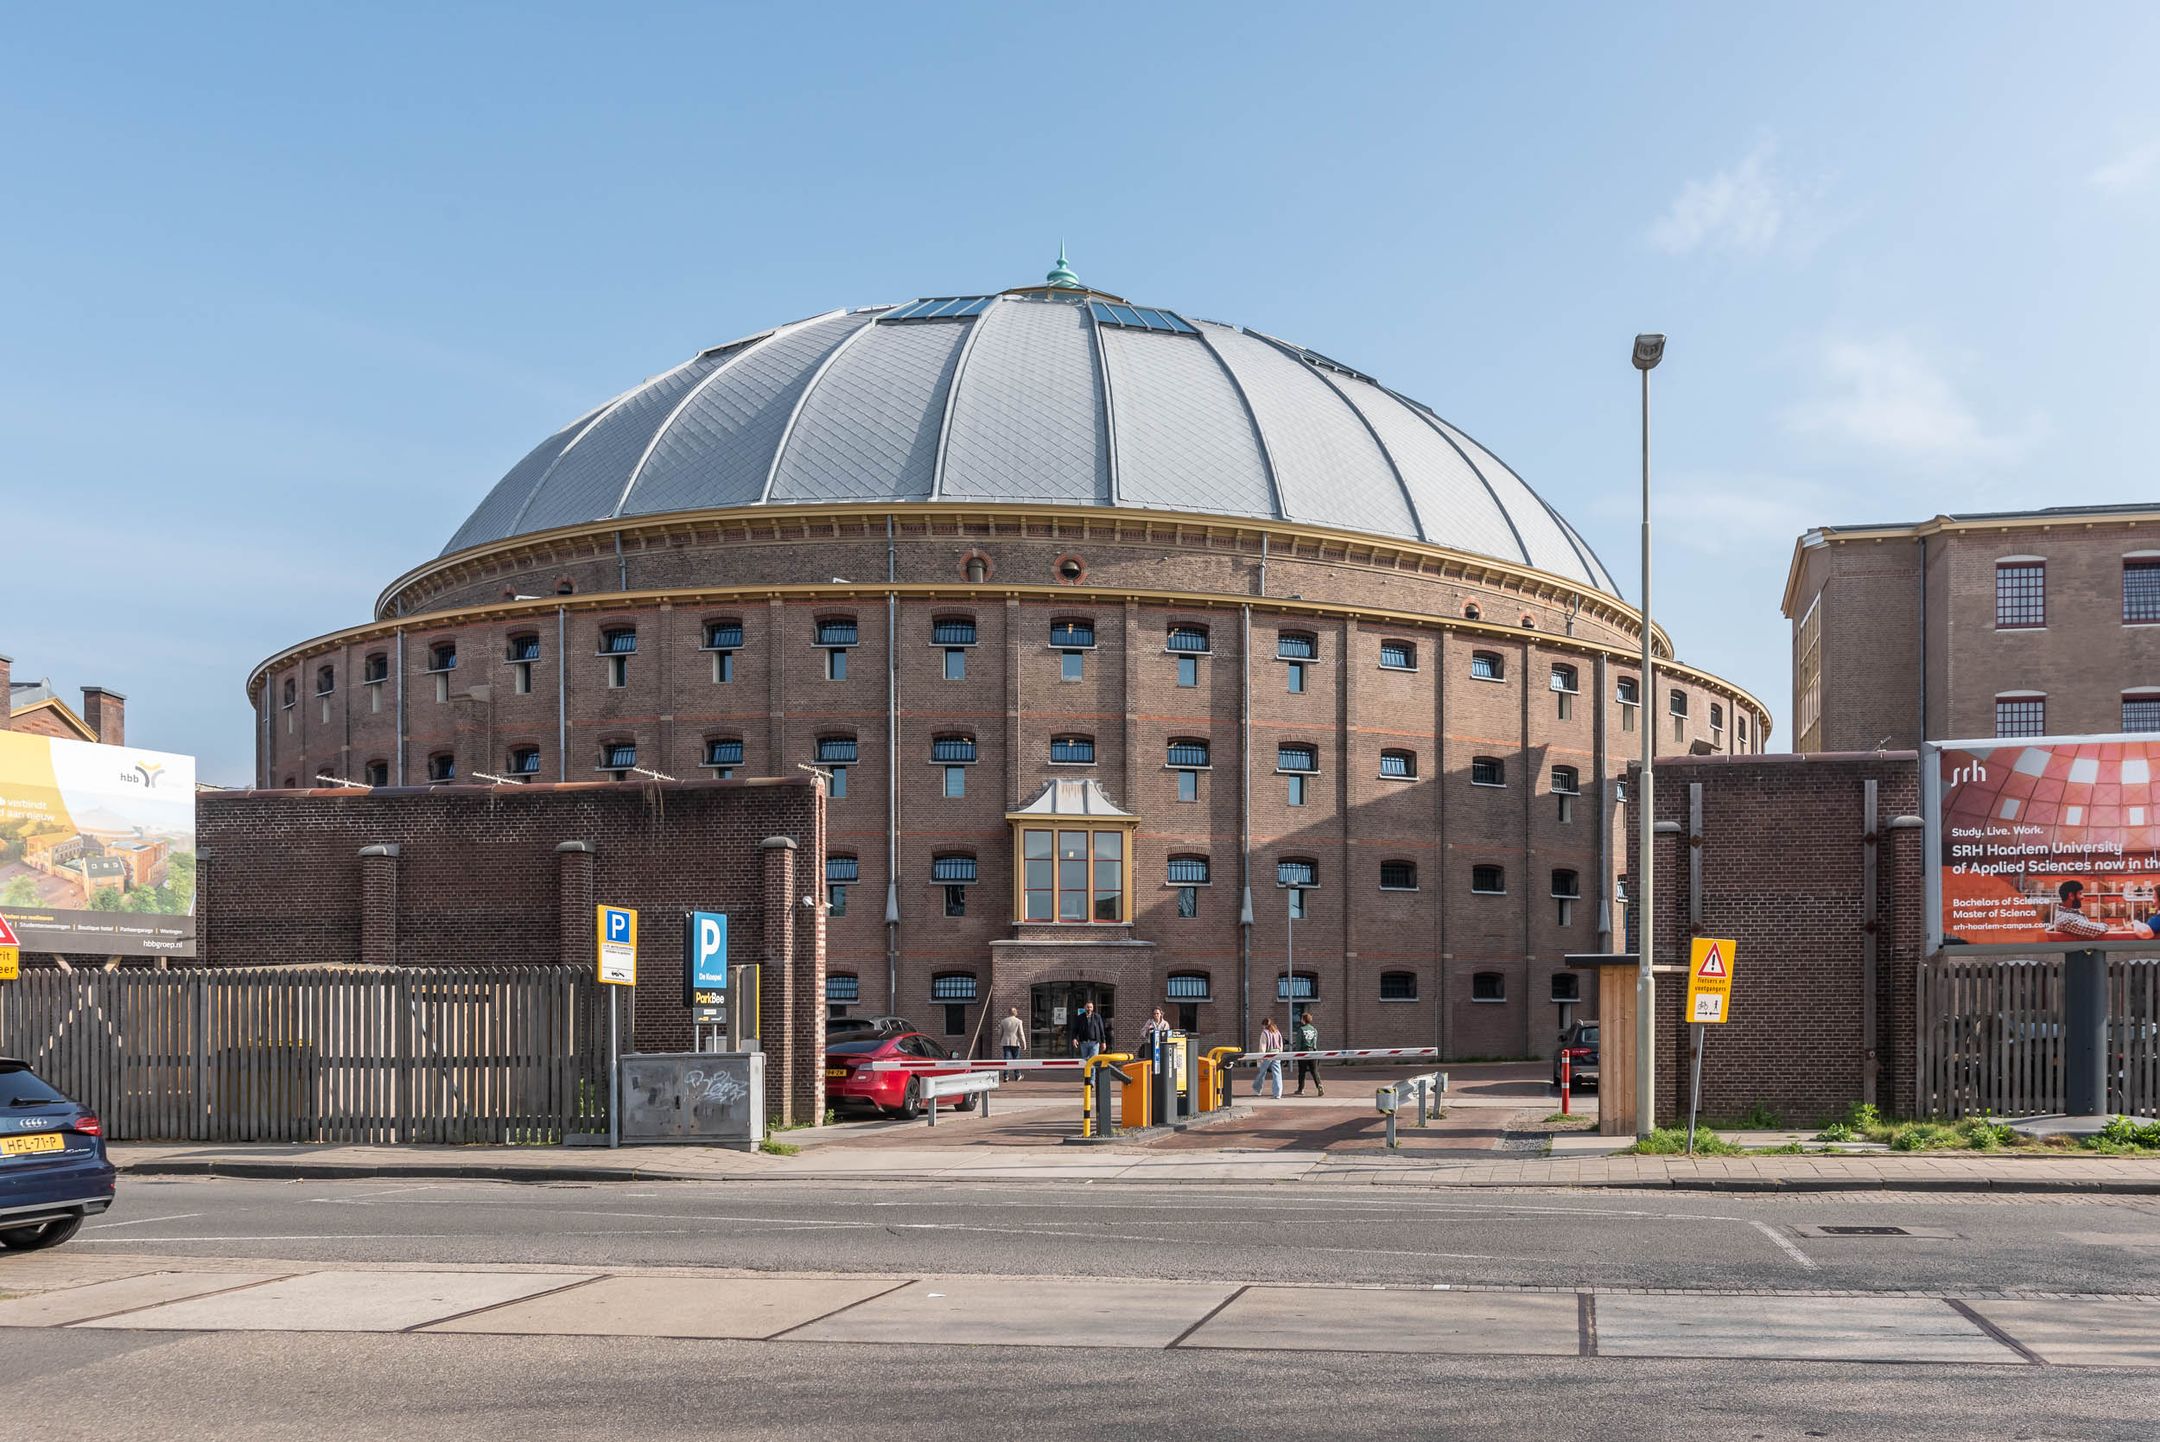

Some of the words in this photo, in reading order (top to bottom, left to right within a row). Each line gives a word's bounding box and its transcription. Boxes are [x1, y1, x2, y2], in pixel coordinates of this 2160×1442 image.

[120, 773, 139, 783] hbb
[1951, 760, 1987, 787] srh
[8, 800, 48, 810] verbindt
[26, 812, 55, 822] nieuw
[1952, 828, 1984, 838] Study.
[1987, 827, 2010, 836] Live.
[2013, 825, 2043, 834] Work.
[1952, 845, 1983, 857] SRH
[1987, 843, 2048, 856] Haarlem
[2053, 841, 2122, 856] University
[1952, 862, 1967, 874] of
[1970, 860, 2025, 877] Applied
[2028, 860, 2091, 872] Sciences
[2095, 860, 2125, 871] now
[2129, 858, 2141, 870] in
[1953, 898, 2000, 908] Bachelors
[2001, 897, 2012, 906] of
[2013, 896, 2050, 905] Science
[1953, 909, 1986, 919] Master
[1988, 909, 1998, 918] of
[2000, 908, 2037, 918] Science
[612, 914, 625, 939] P
[1953, 922, 2051, 931] srh-haarlem-campus.com
[143, 940, 183, 950] hbbgroep.nl
[696, 991, 725, 1005] ParkBee
[7, 1136, 56, 1152] HFL-71-P
